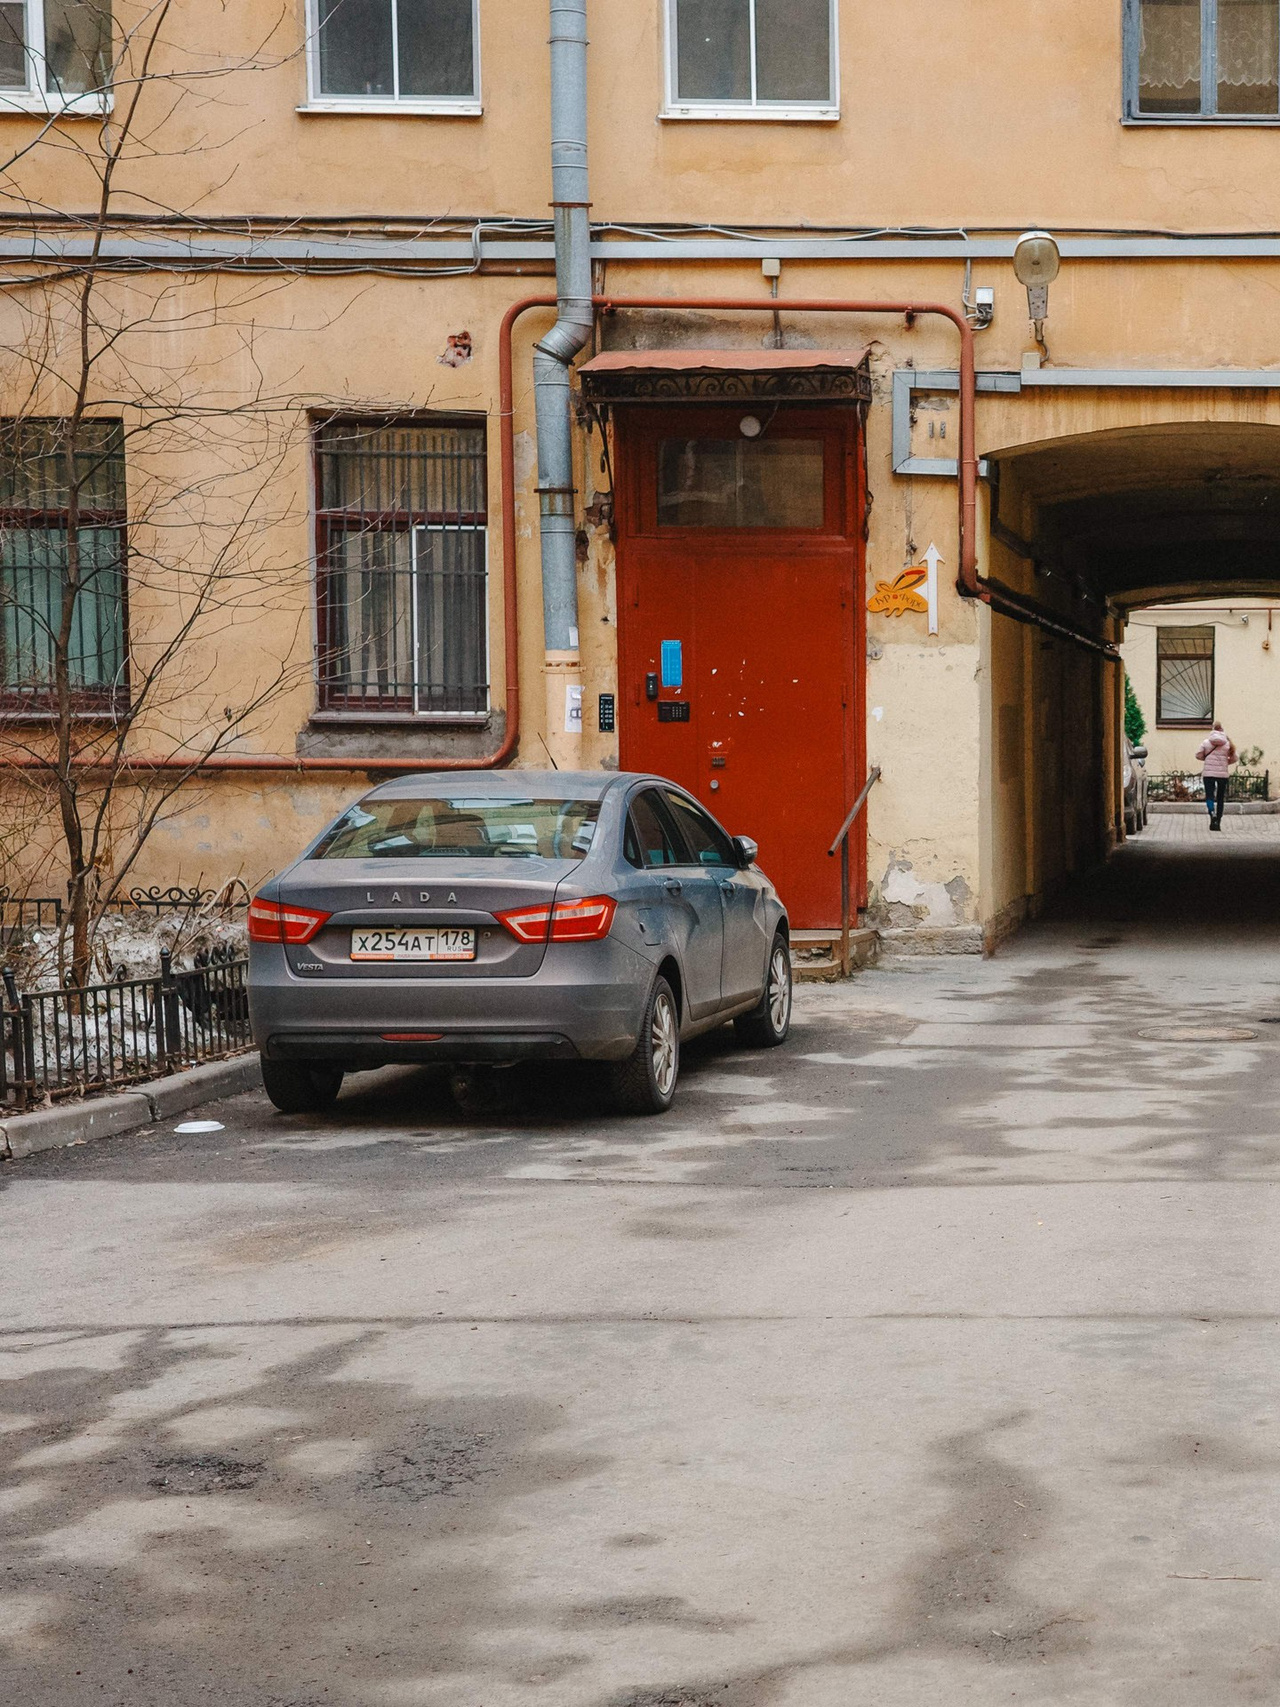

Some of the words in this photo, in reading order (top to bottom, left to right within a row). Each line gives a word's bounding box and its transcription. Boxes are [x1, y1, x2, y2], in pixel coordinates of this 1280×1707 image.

[366, 892, 457, 903] LADA
[358, 932, 435, 952] Х254АТ
[441, 930, 470, 946] 178
[297, 962, 324, 971] VESTA
